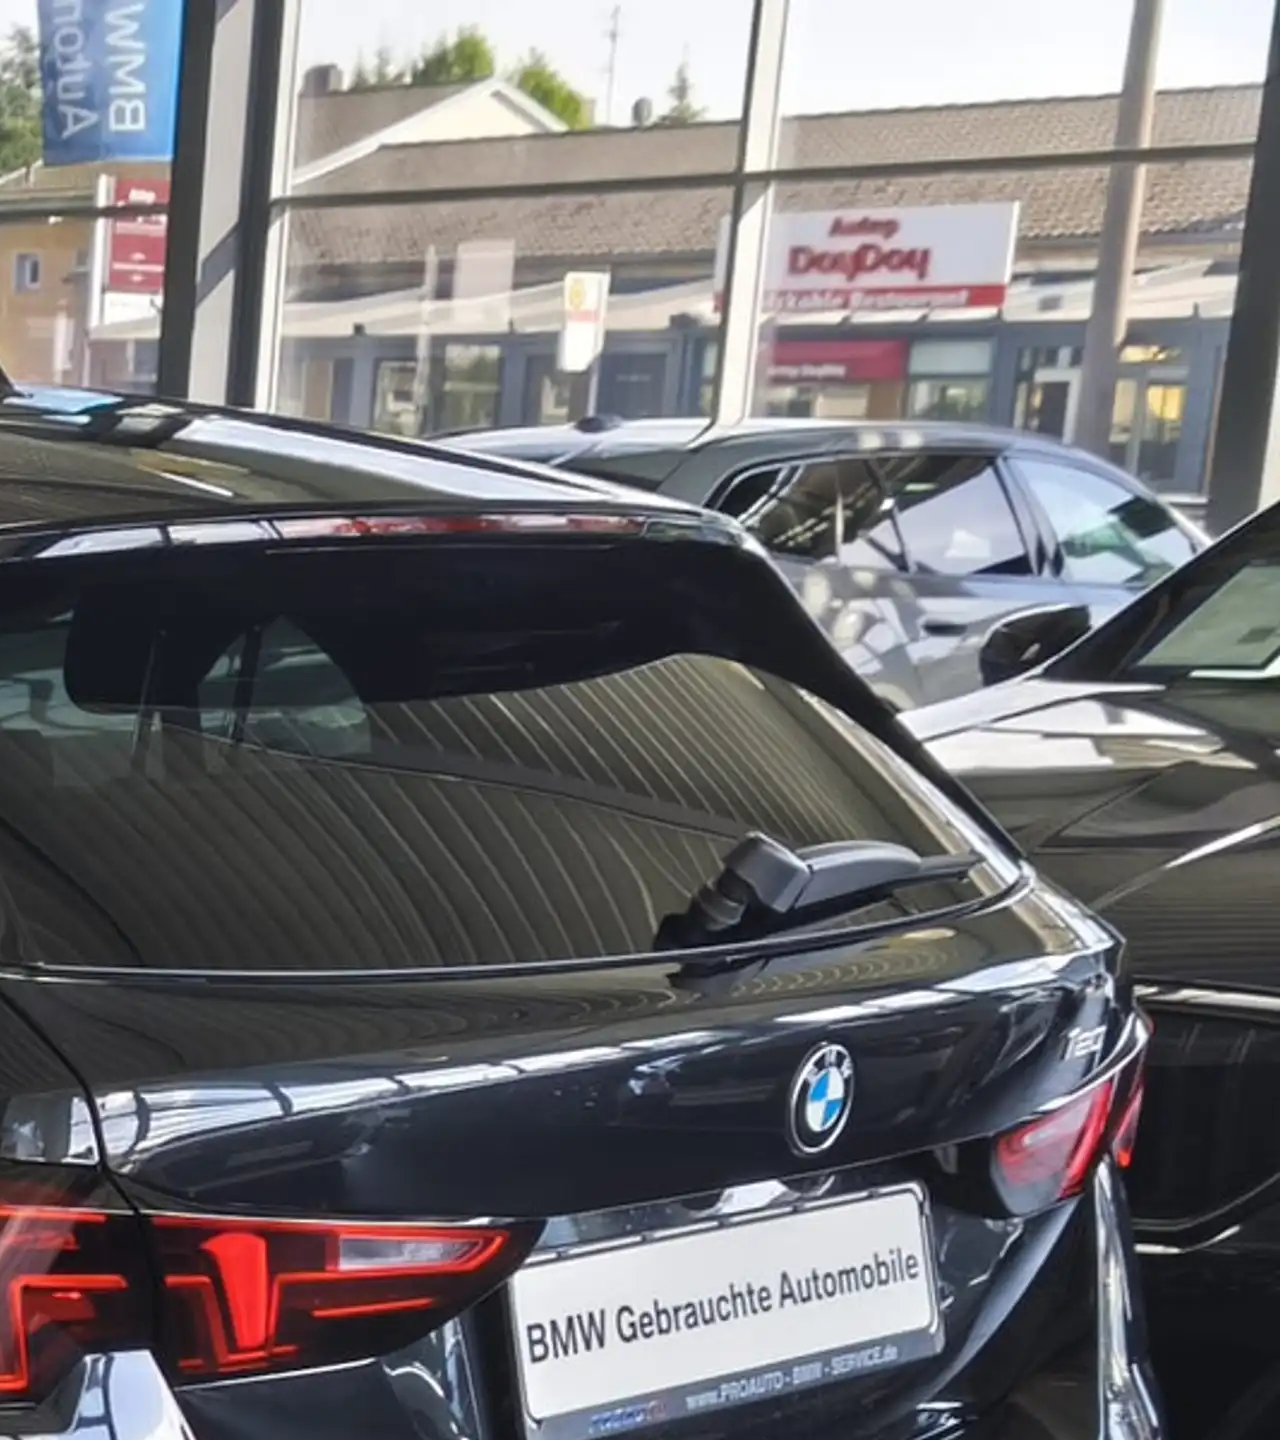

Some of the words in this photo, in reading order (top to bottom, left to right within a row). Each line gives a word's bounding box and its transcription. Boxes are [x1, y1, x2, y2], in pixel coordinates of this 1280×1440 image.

[527, 1309, 606, 1363] BMW
[617, 1283, 772, 1343] Gebrauchte
[778, 1248, 920, 1309] Automobile
